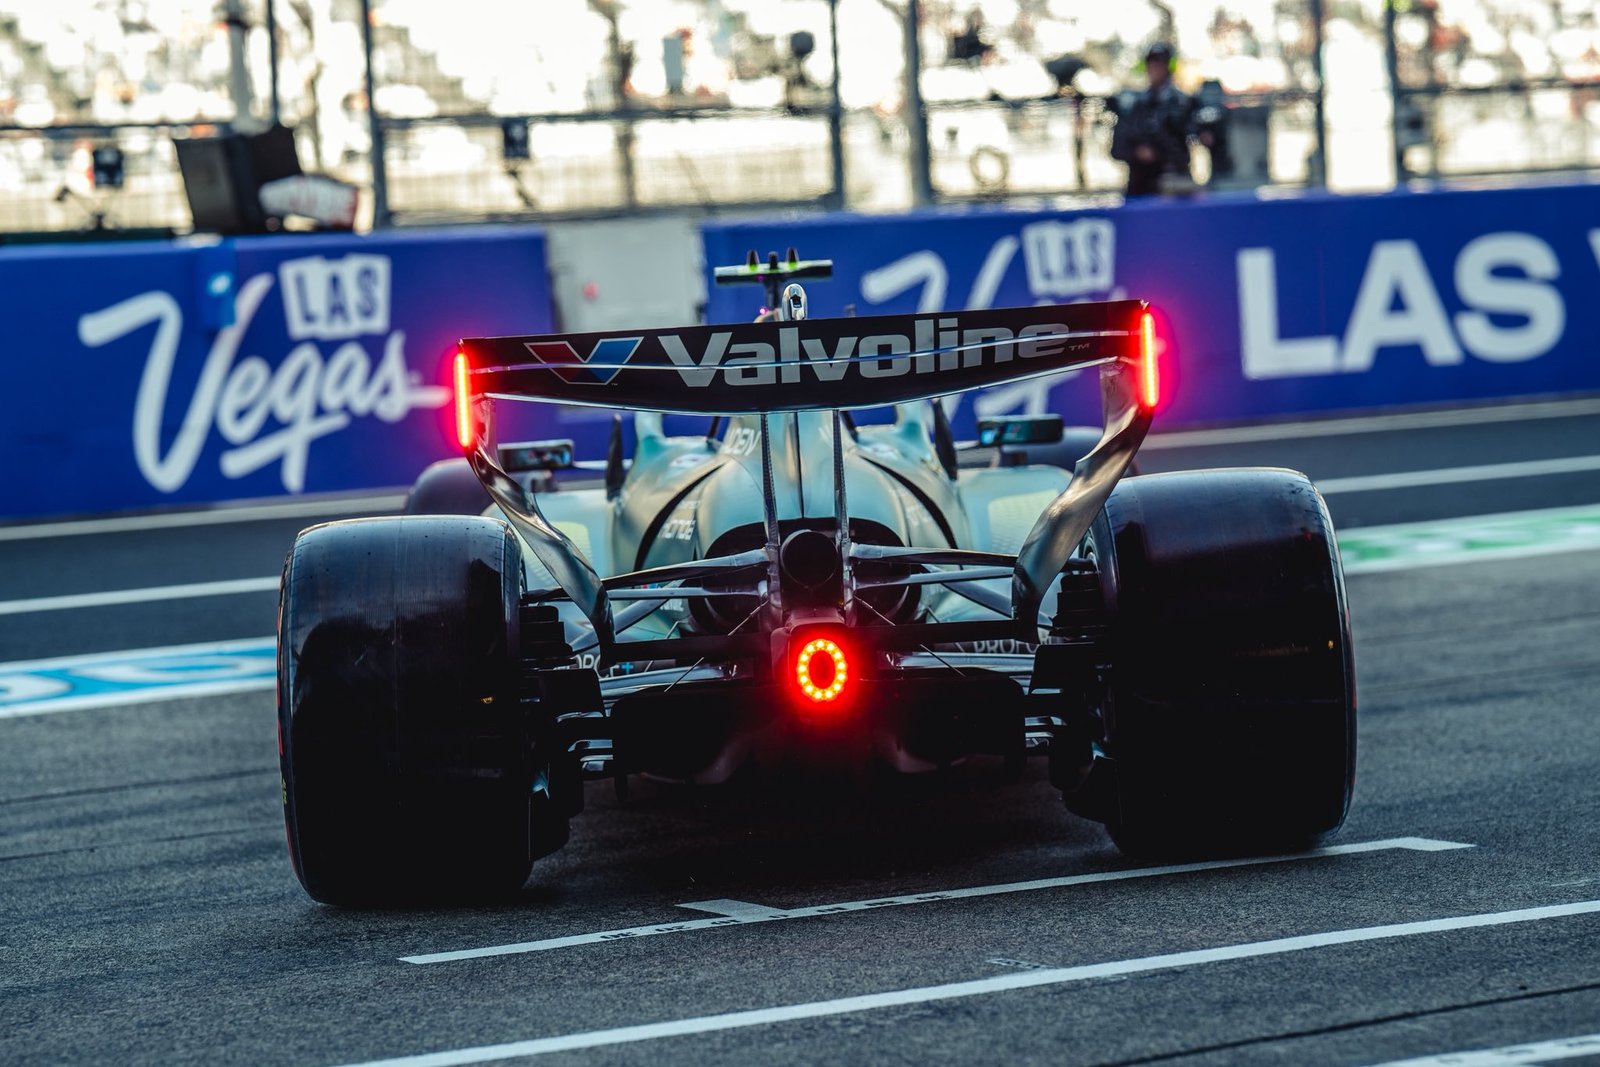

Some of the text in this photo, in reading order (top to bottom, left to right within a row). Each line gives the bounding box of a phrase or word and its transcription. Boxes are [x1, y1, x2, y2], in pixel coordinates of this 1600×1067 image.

[294, 262, 382, 329] LAS
[1236, 231, 1566, 380] LAS
[78, 273, 450, 493] Vegas
[657, 317, 1069, 387] Valvoline
